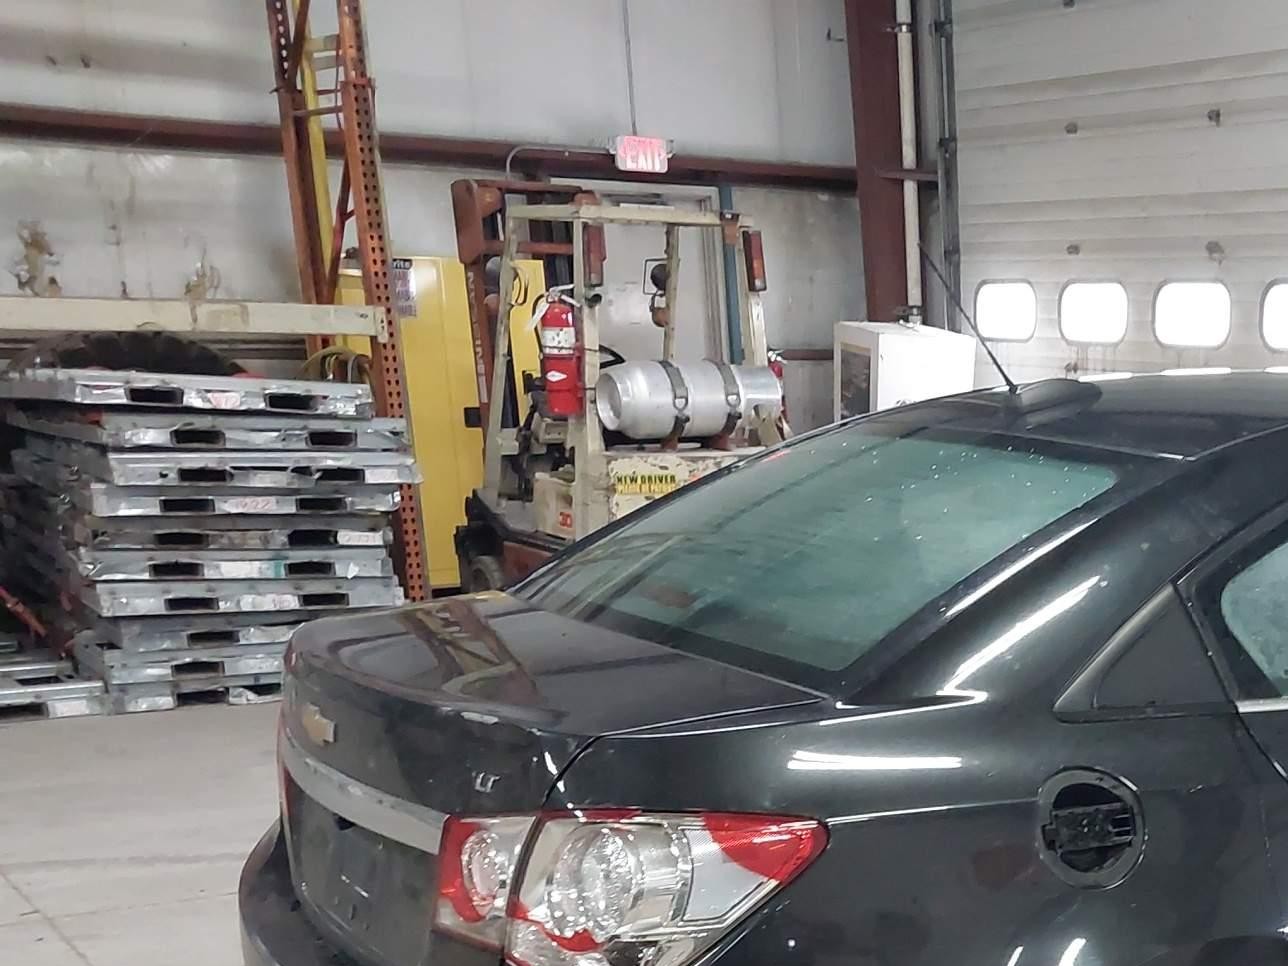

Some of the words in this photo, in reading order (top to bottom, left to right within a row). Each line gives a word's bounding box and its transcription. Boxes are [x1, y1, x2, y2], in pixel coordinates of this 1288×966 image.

[624, 137, 661, 171] EXIT
[617, 475, 637, 483] NEW
[640, 475, 676, 484] DRIVER
[475, 772, 500, 792] LT
